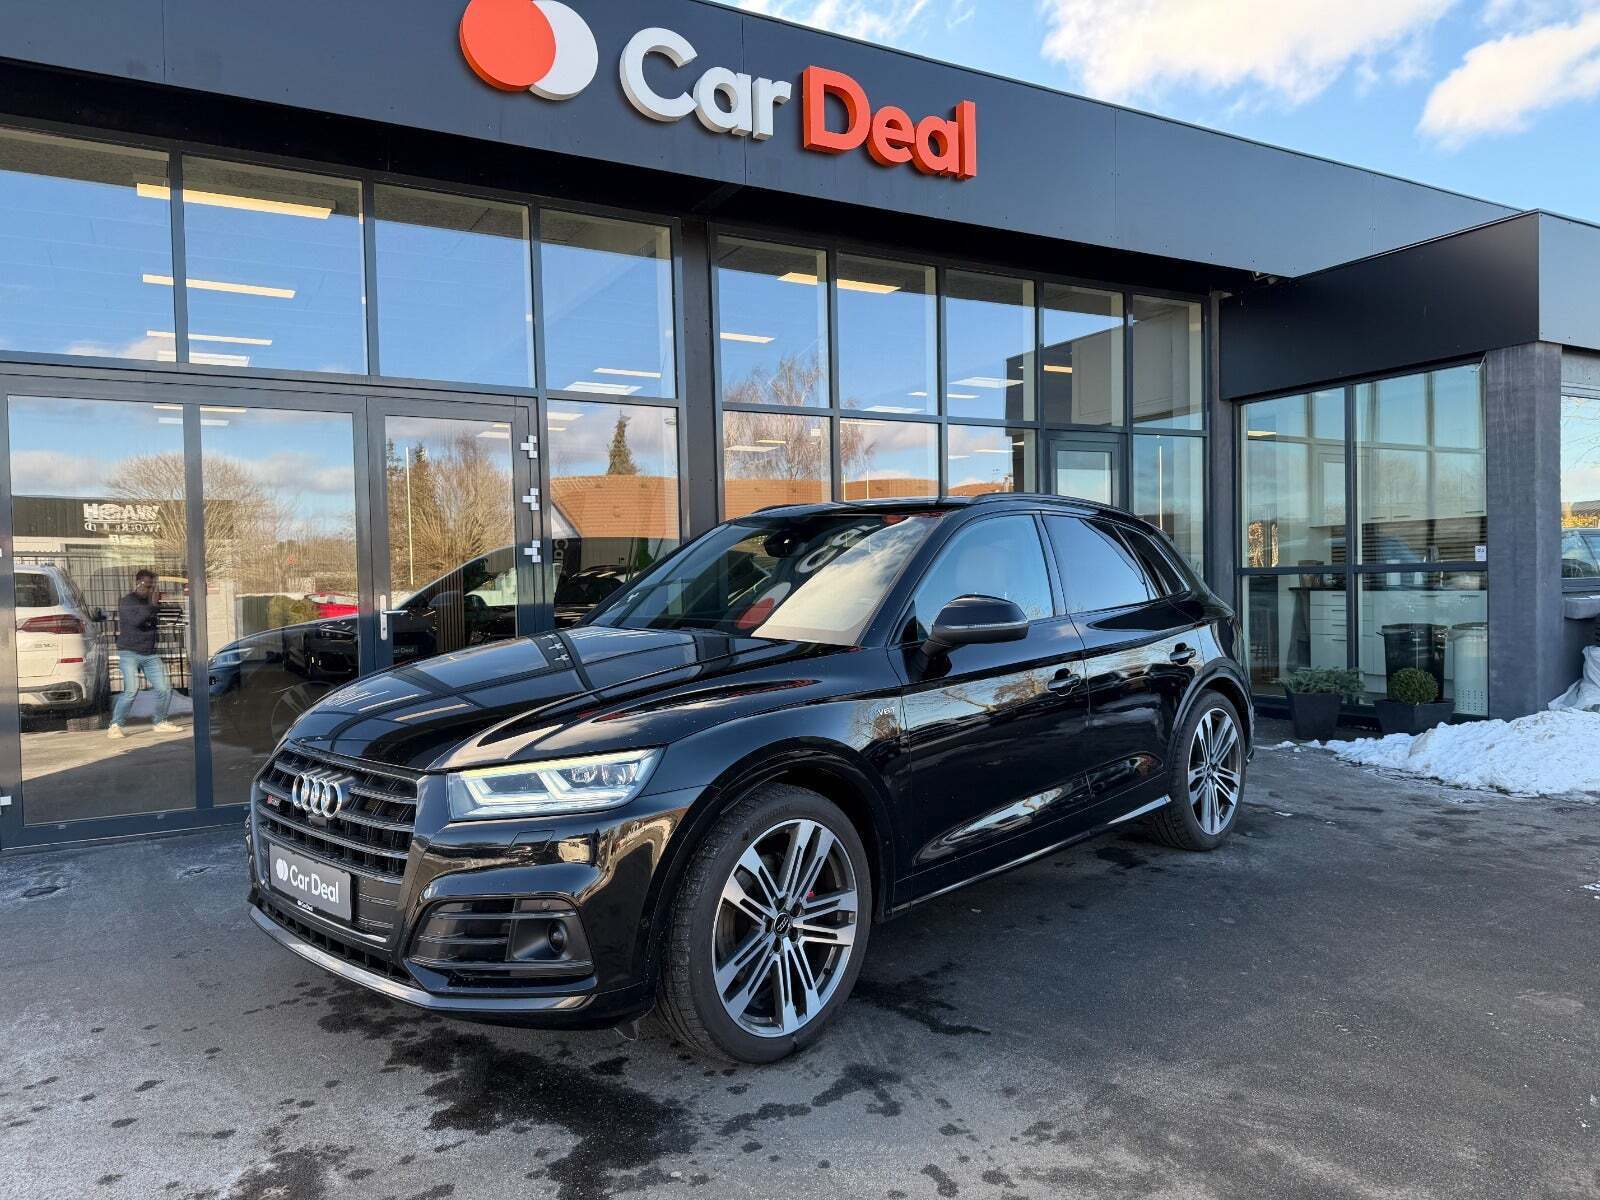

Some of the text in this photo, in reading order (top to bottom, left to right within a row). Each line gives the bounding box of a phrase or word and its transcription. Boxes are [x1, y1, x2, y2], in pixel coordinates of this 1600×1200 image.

[619, 27, 977, 181] Car Deal
[290, 865, 339, 904] Car Deal
